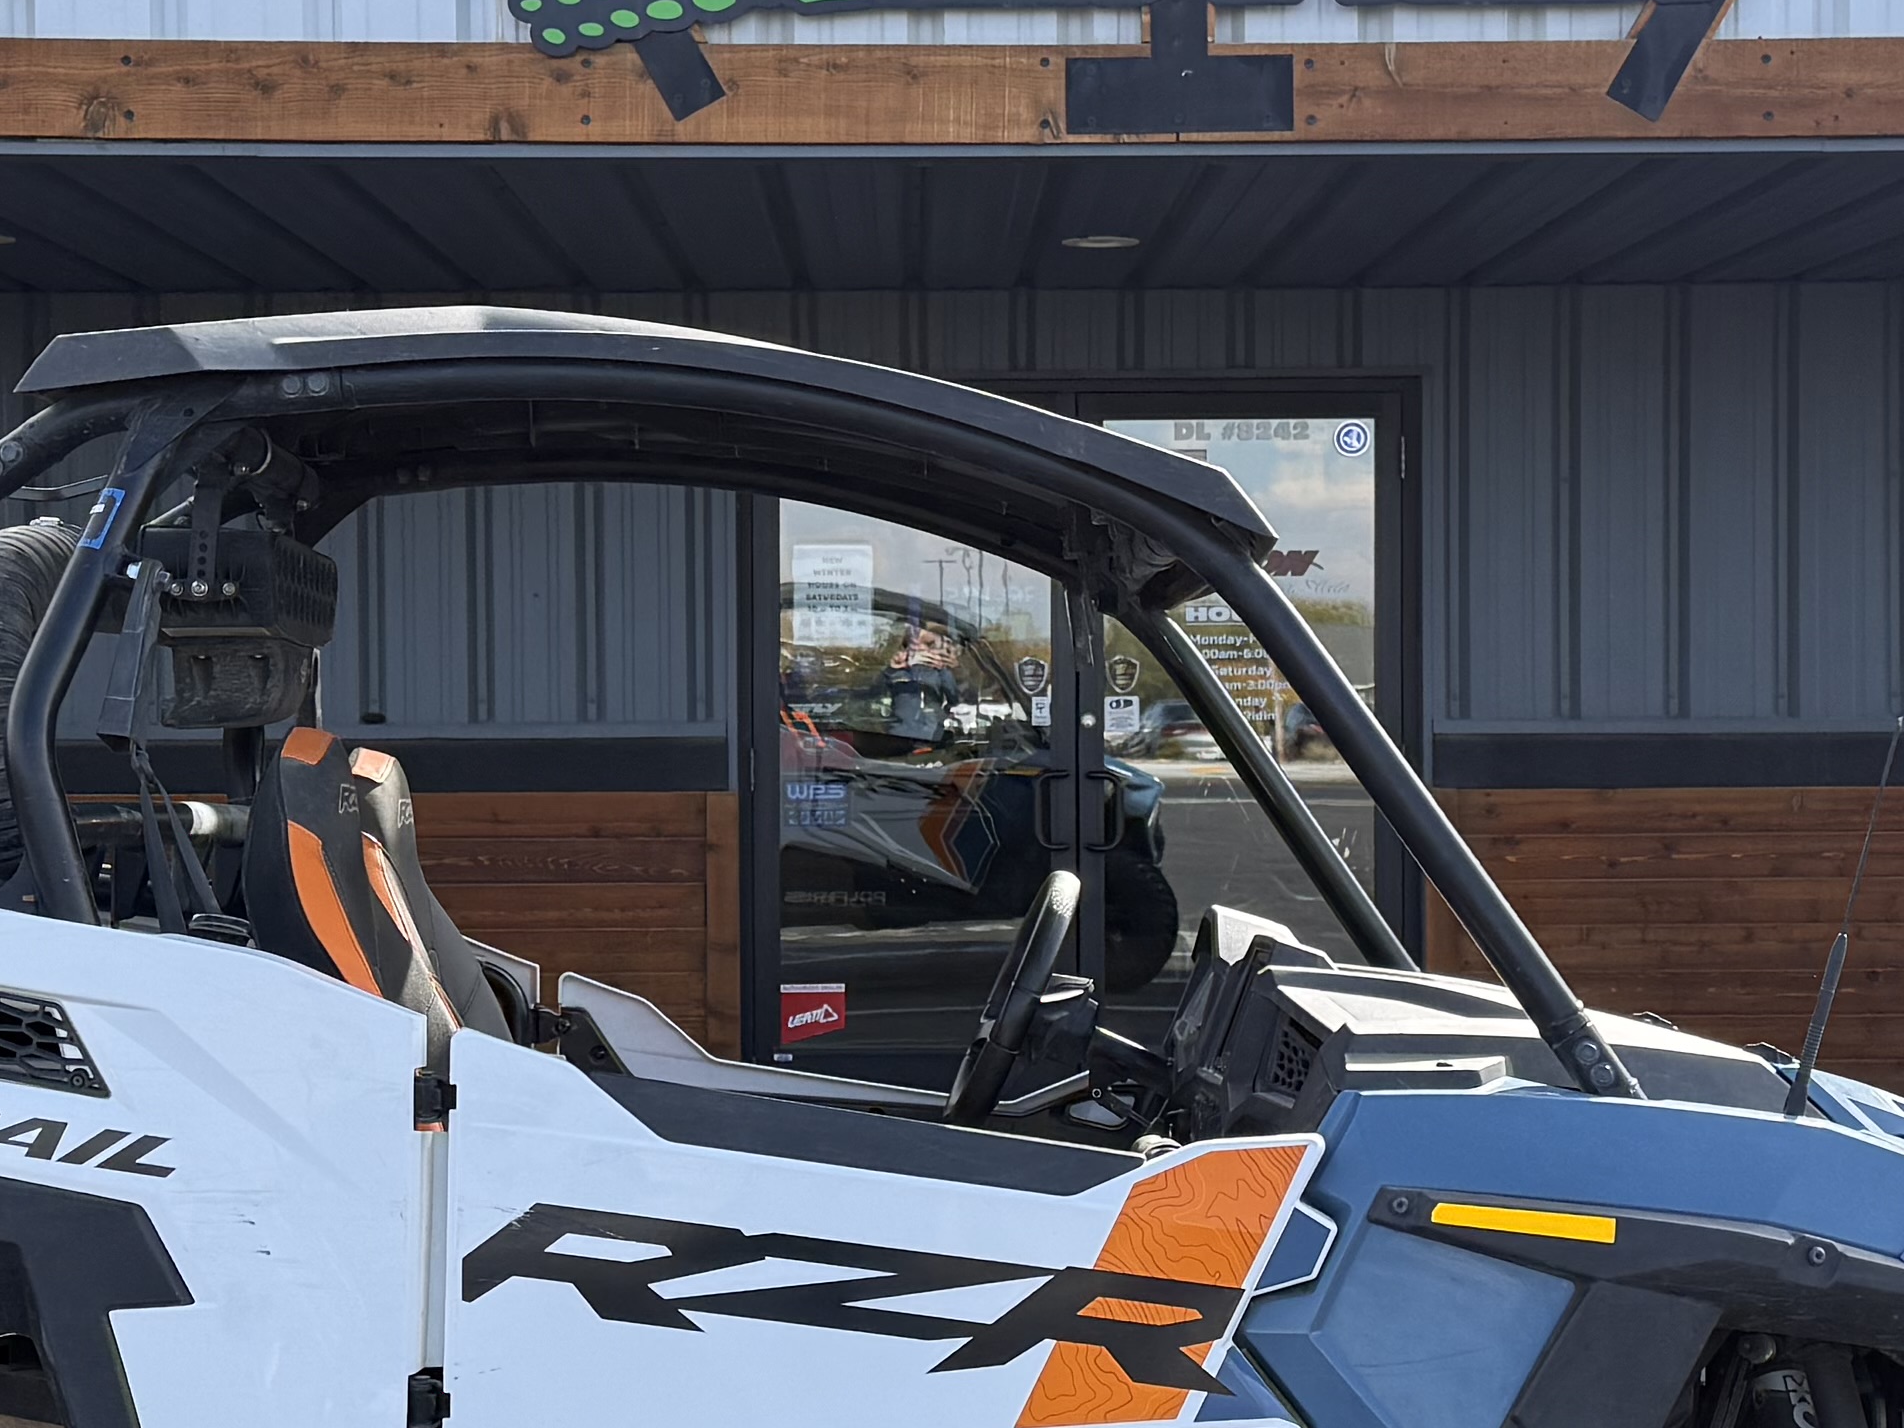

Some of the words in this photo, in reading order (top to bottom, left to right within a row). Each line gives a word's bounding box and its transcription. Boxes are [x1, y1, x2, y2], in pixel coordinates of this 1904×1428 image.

[1174, 421, 1211, 441] DL
[1220, 421, 1310, 441] #8242
[461, 1202, 1247, 1398] RZR
